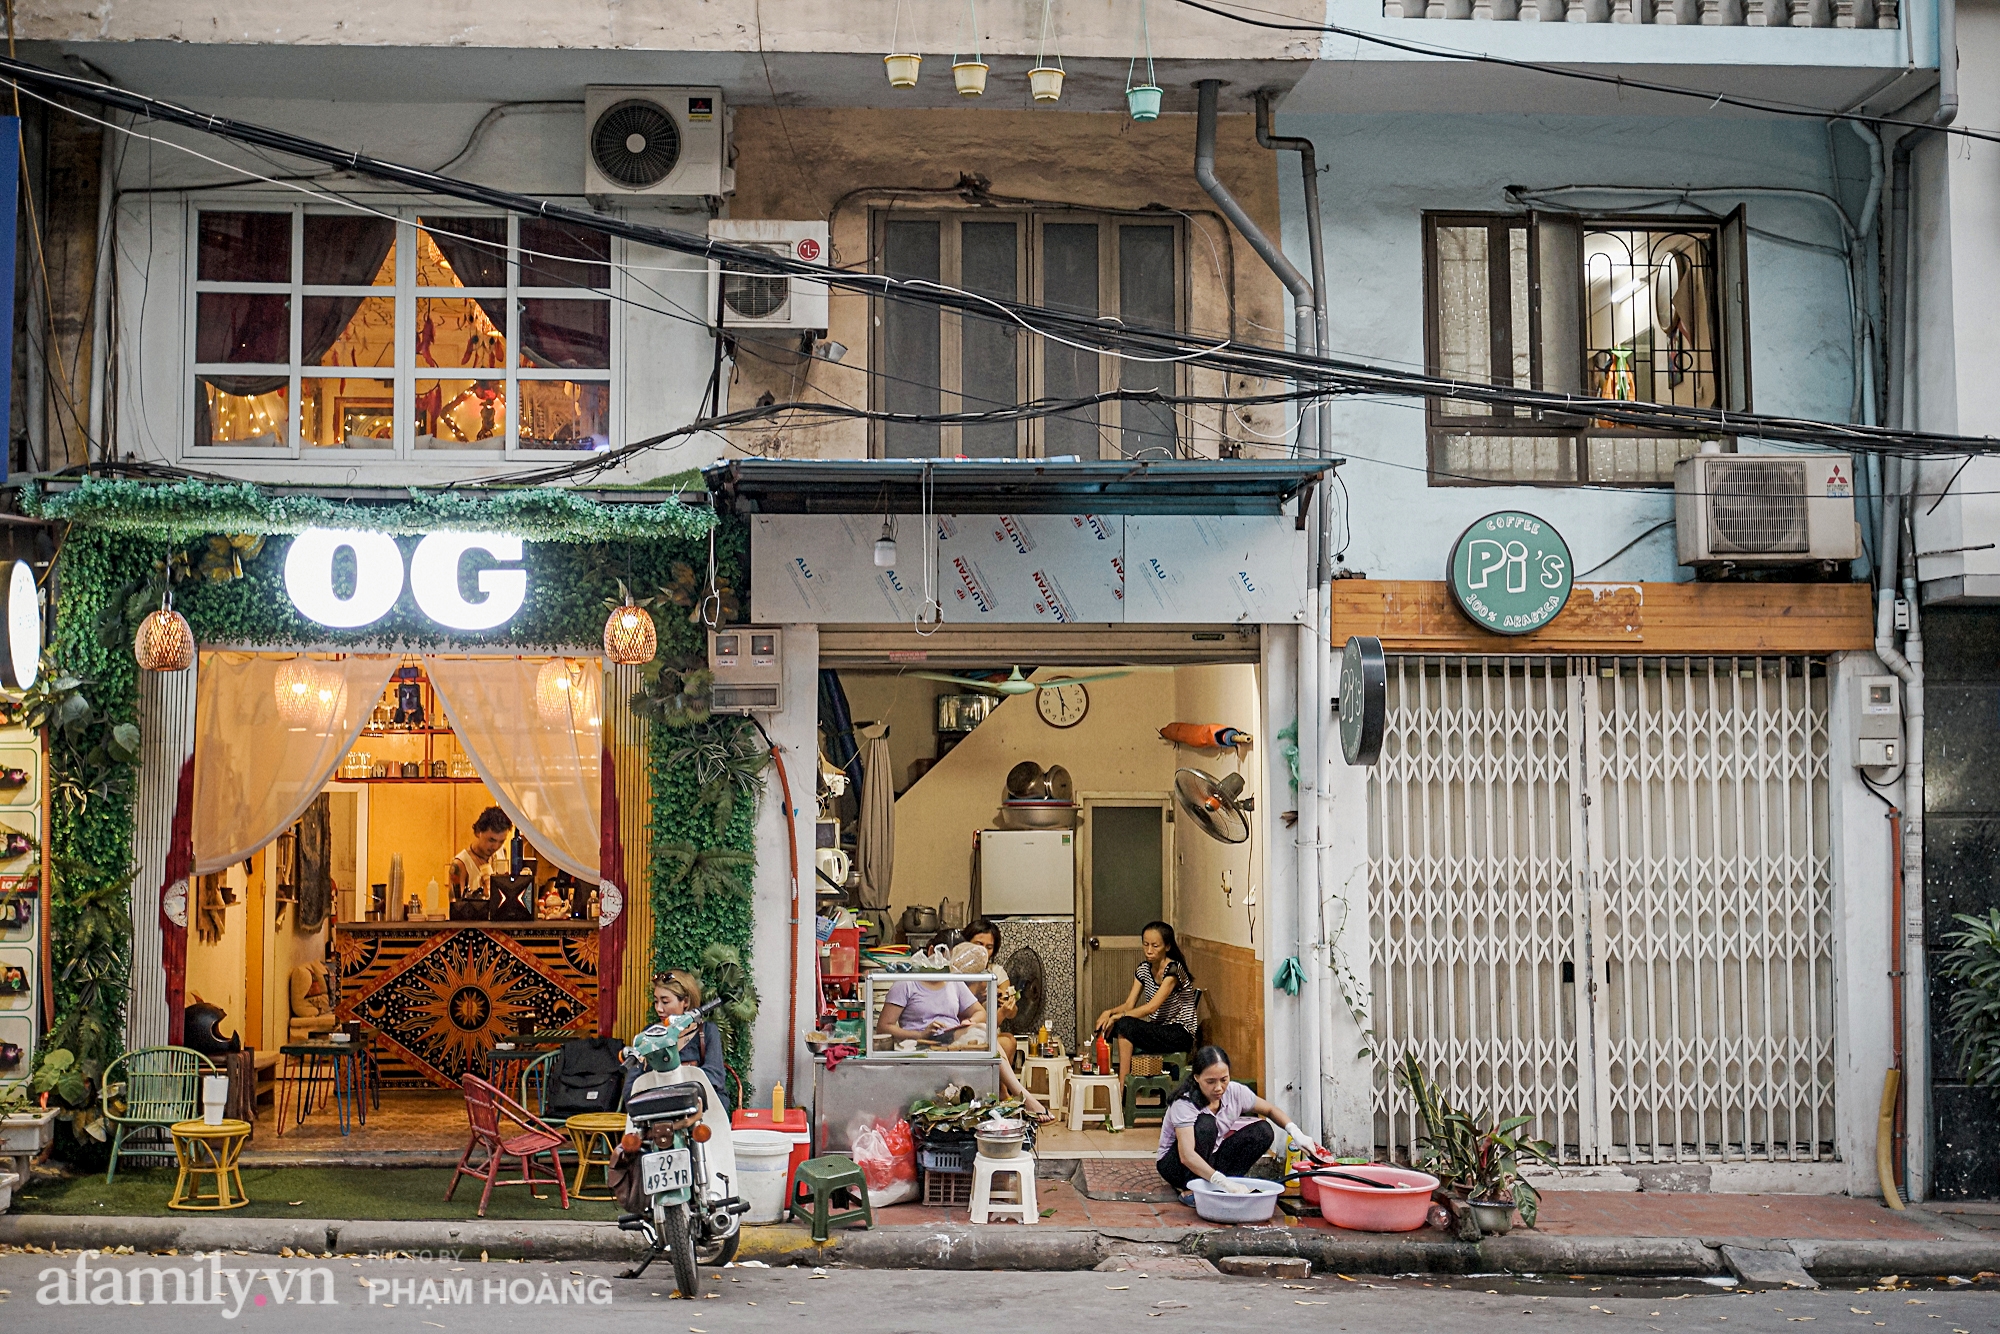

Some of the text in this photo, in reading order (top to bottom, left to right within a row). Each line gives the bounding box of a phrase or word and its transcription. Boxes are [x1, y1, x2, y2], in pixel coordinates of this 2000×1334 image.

[1486, 516, 1540, 535] COFFEE
[284, 527, 527, 630] OG
[796, 557, 813, 579] ALU
[1150, 558, 1166, 580] ALU
[886, 570, 903, 592] ALU
[953, 557, 988, 612] ALUTITAN
[1239, 571, 1255, 593] ALU
[1466, 594, 1560, 627] 100% ARABICA
[659, 1155, 673, 1171] 29
